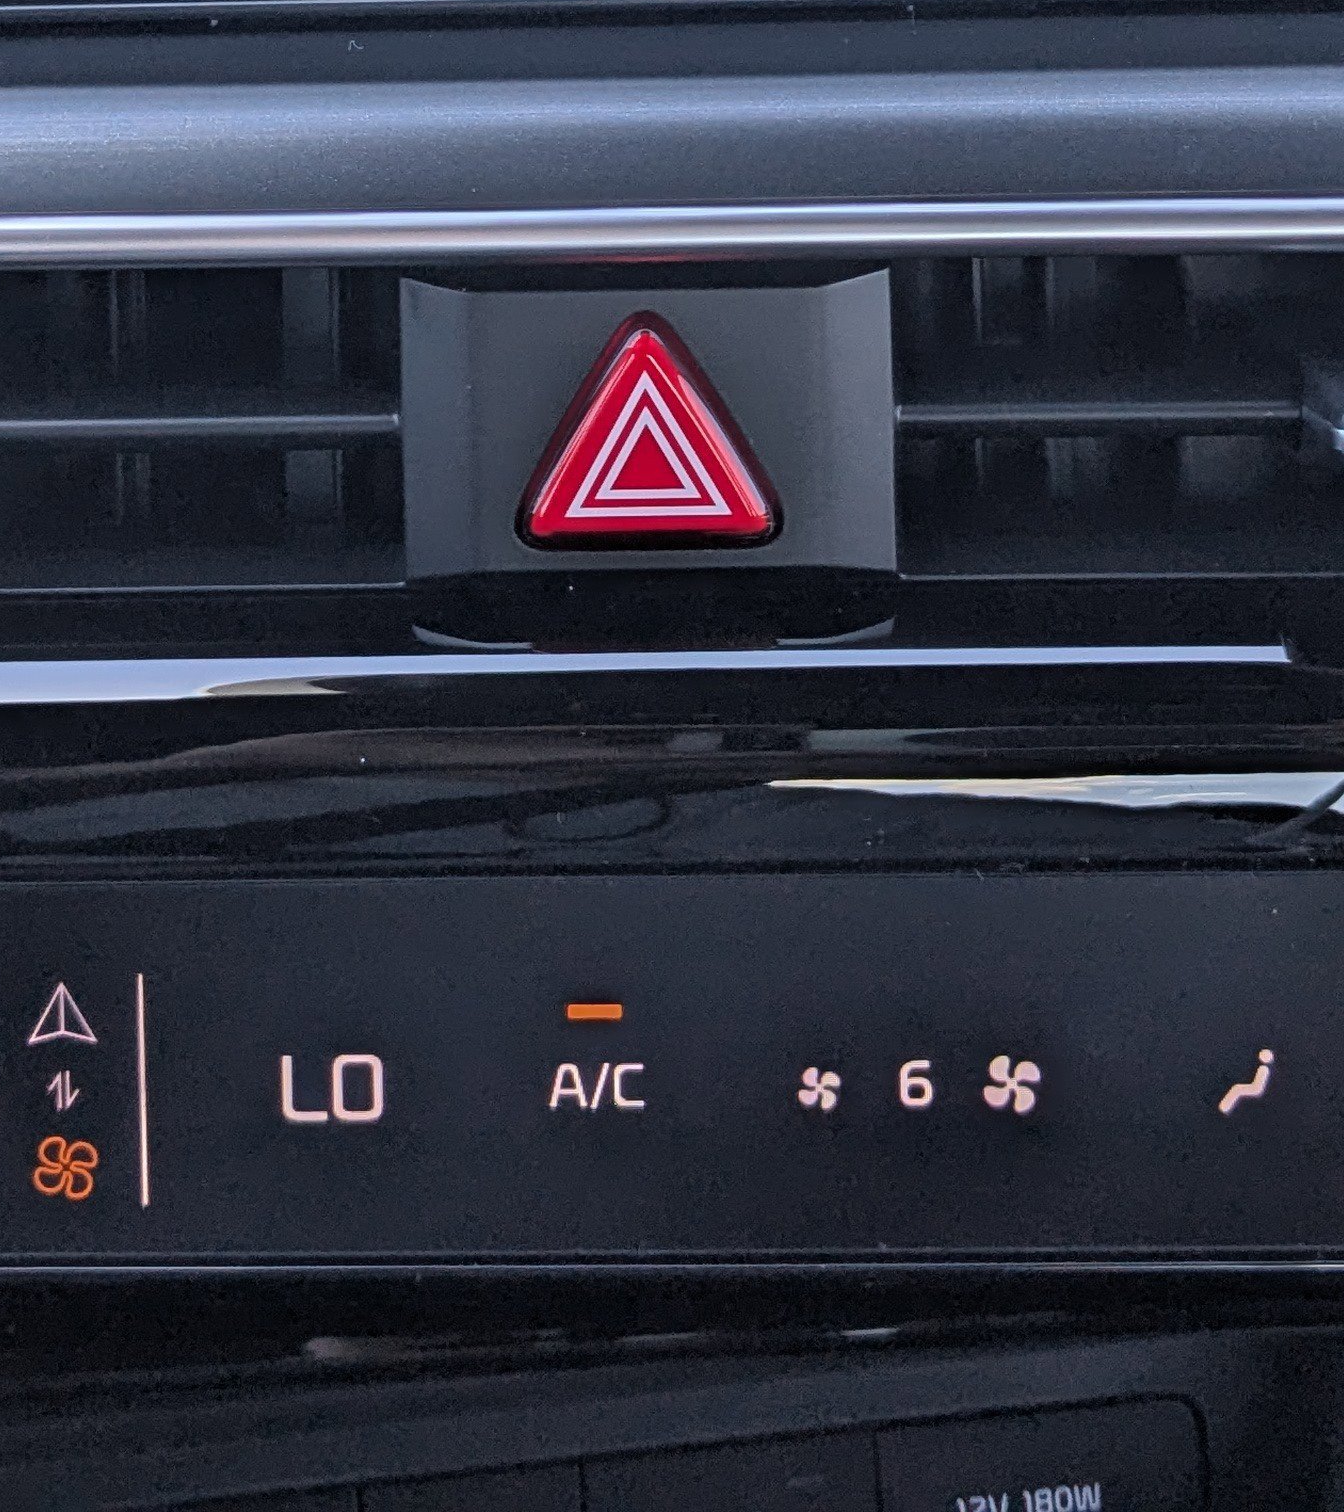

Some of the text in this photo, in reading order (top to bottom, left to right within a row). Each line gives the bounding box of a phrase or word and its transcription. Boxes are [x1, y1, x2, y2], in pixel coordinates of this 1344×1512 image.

[280, 1053, 385, 1124] LO
[547, 1061, 646, 1111] A/C
[898, 1059, 935, 1109] 6
